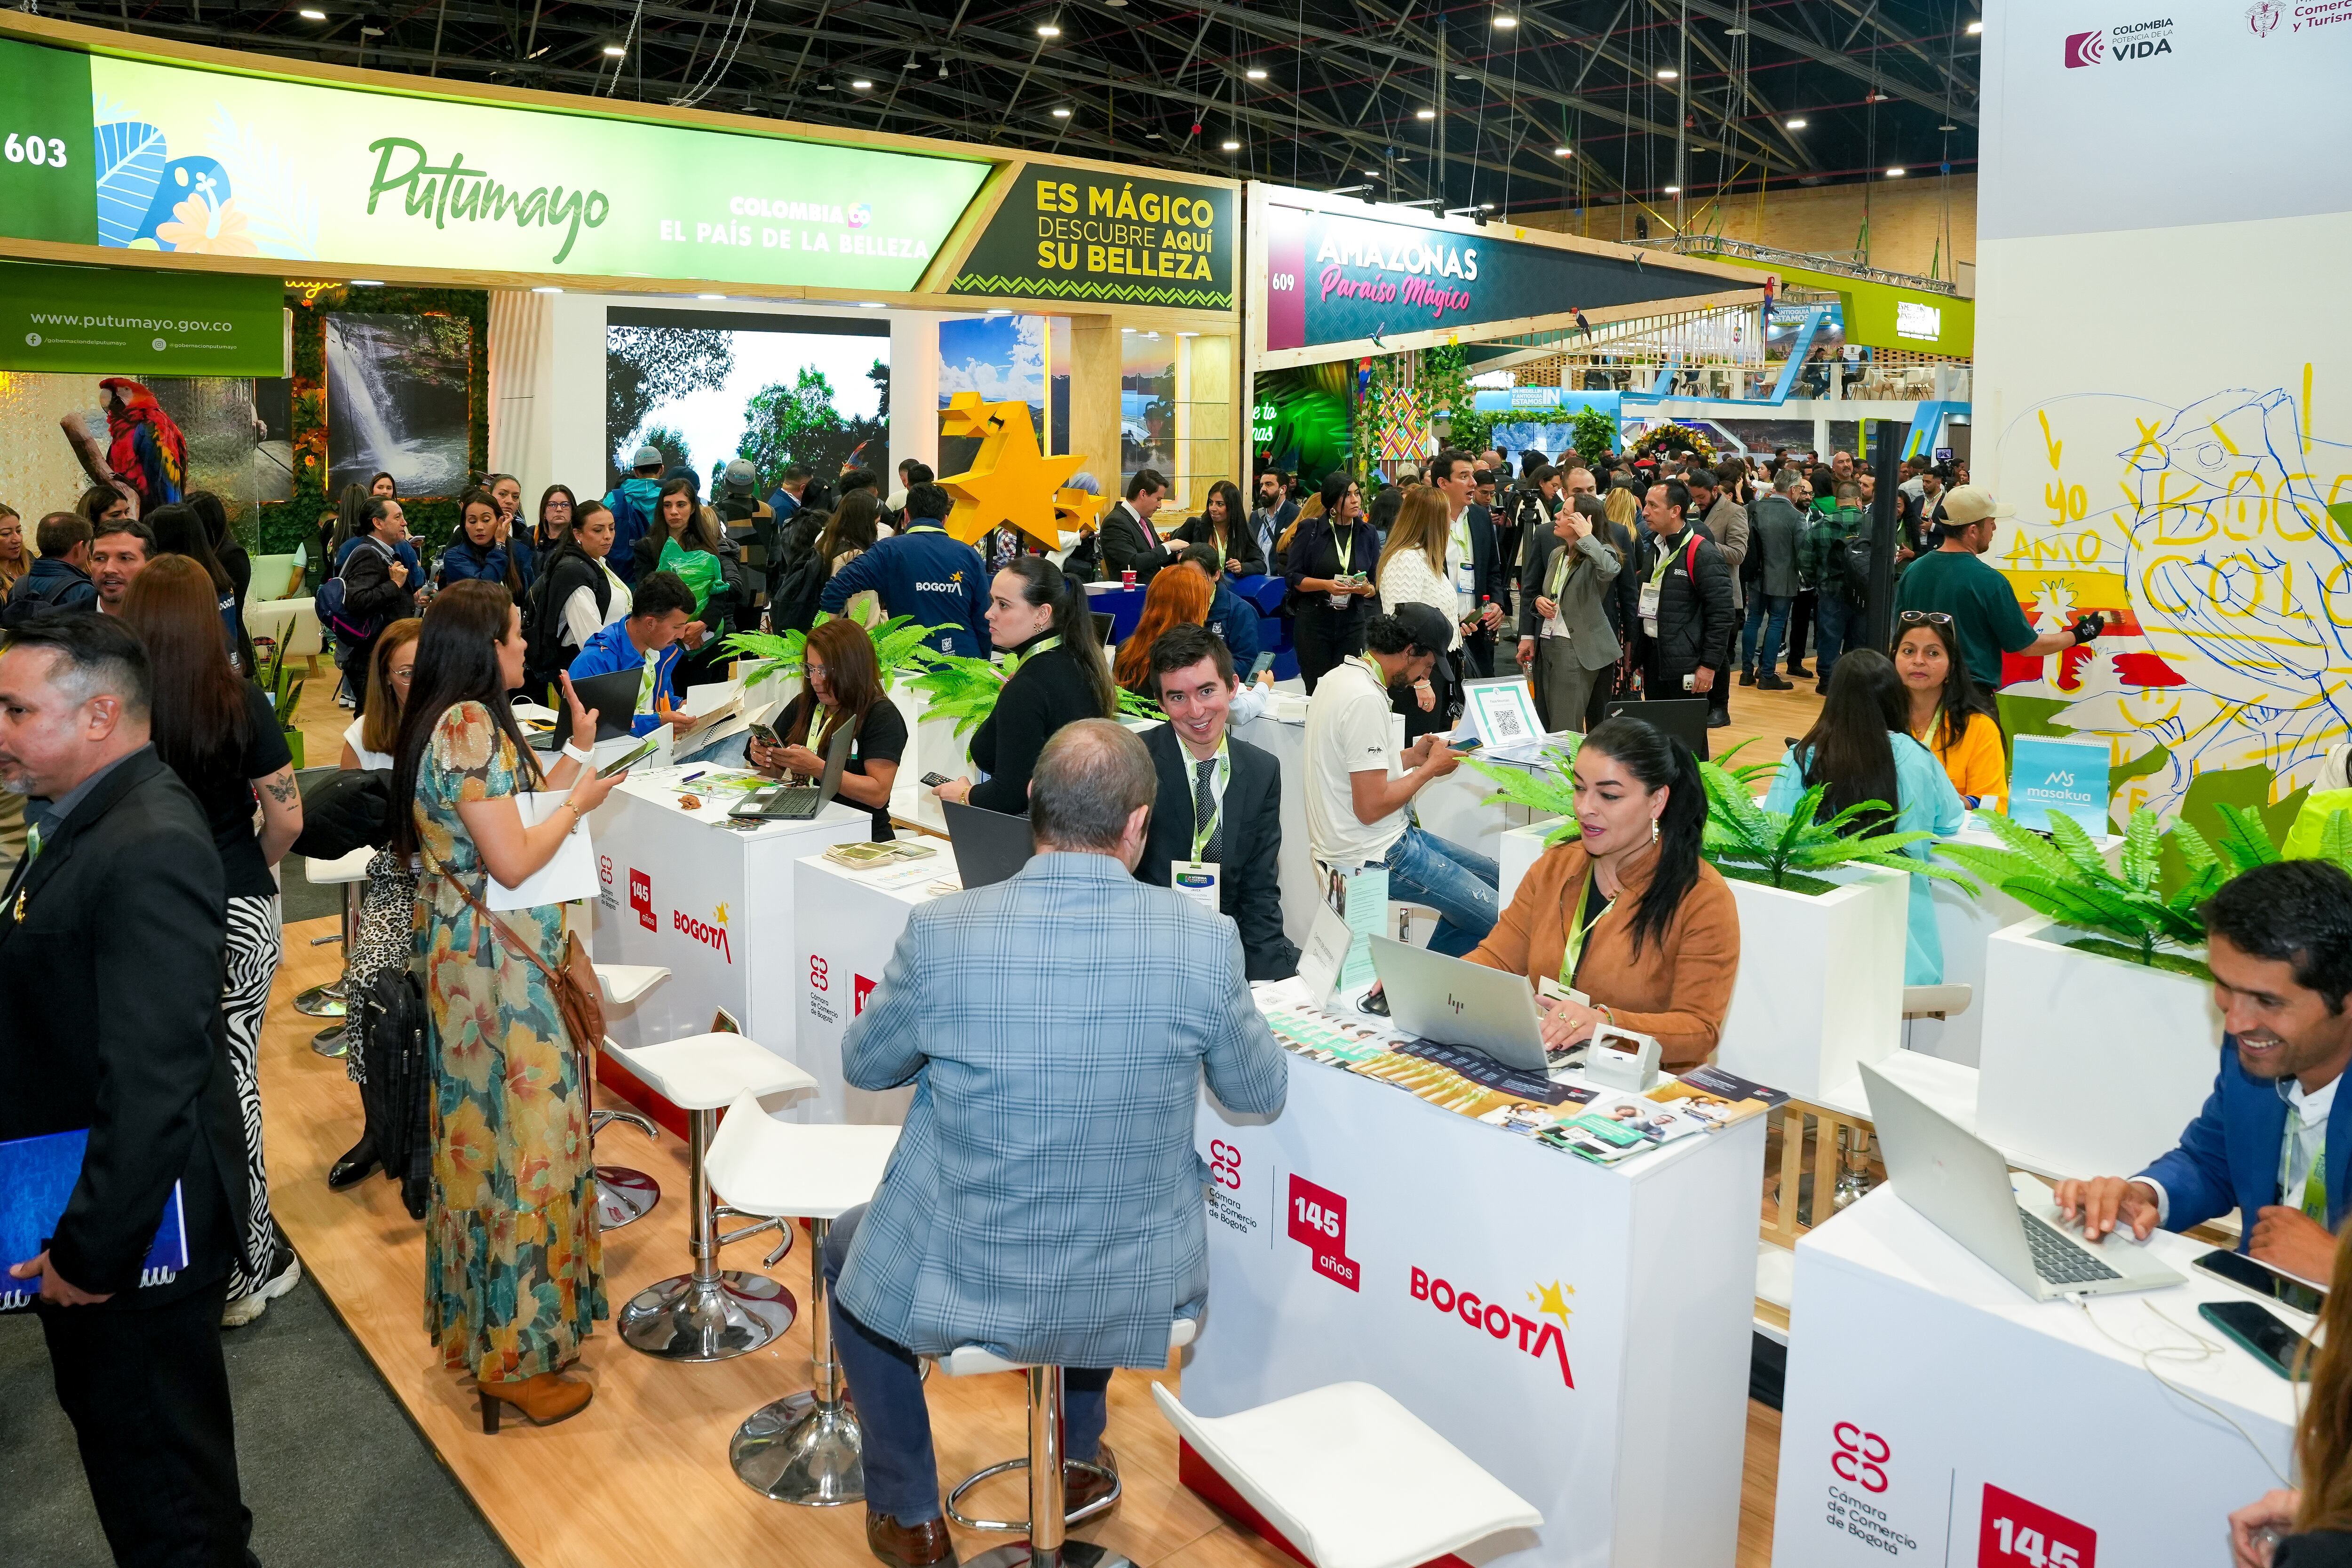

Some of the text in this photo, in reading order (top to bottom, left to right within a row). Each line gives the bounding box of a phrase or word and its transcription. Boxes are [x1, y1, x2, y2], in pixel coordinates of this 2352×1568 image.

[2112, 33, 2149, 45] POTENCIA
[2113, 18, 2174, 36] COLOMBIA
[2293, 22, 2302, 32] y
[2112, 38, 2172, 62] VIDA
[4, 133, 68, 168] 603
[367, 137, 609, 264] Putumayo
[730, 196, 844, 224] COLOMBIA
[1037, 180, 1214, 229] ES MÁGICO
[660, 219, 930, 259] EL PAÍS DE LA BELLEZA
[1038, 216, 1213, 253] DESCUBRE AQUÍ
[1037, 240, 1213, 282] SU BELLEZA
[1316, 236, 1478, 281] AMAZONAS
[1272, 272, 1295, 292] 609
[1319, 263, 1470, 318] Paraíso Mágico
[30, 313, 232, 333] www.putumayo.gov.co
[44, 337, 127, 347] /gobernaciondelputumayo
[169, 342, 237, 350] @gobernacionputumayo
[1542, 389, 1560, 405] IN
[1263, 402, 1277, 420] to
[2002, 528, 2102, 570] AMO
[2027, 788, 2091, 802] masakua
[632, 880, 649, 902] 145
[642, 913, 655, 926] años
[810, 992, 829, 1006] Cámara
[817, 1003, 838, 1019] Comercio
[817, 1010, 833, 1024] Bogotá
[1209, 1187, 1241, 1210] Cámara
[1209, 1198, 1257, 1227] de Comercio
[1209, 1208, 1247, 1234] de Bogotá
[1295, 1196, 1339, 1238] 145
[1319, 1255, 1353, 1281] años
[1828, 1485, 1886, 1521] Cámara
[1826, 1513, 1898, 1555] de Bogotá
[1827, 1500, 1917, 1549] de Comercio
[1993, 1516, 2080, 1568] 145
